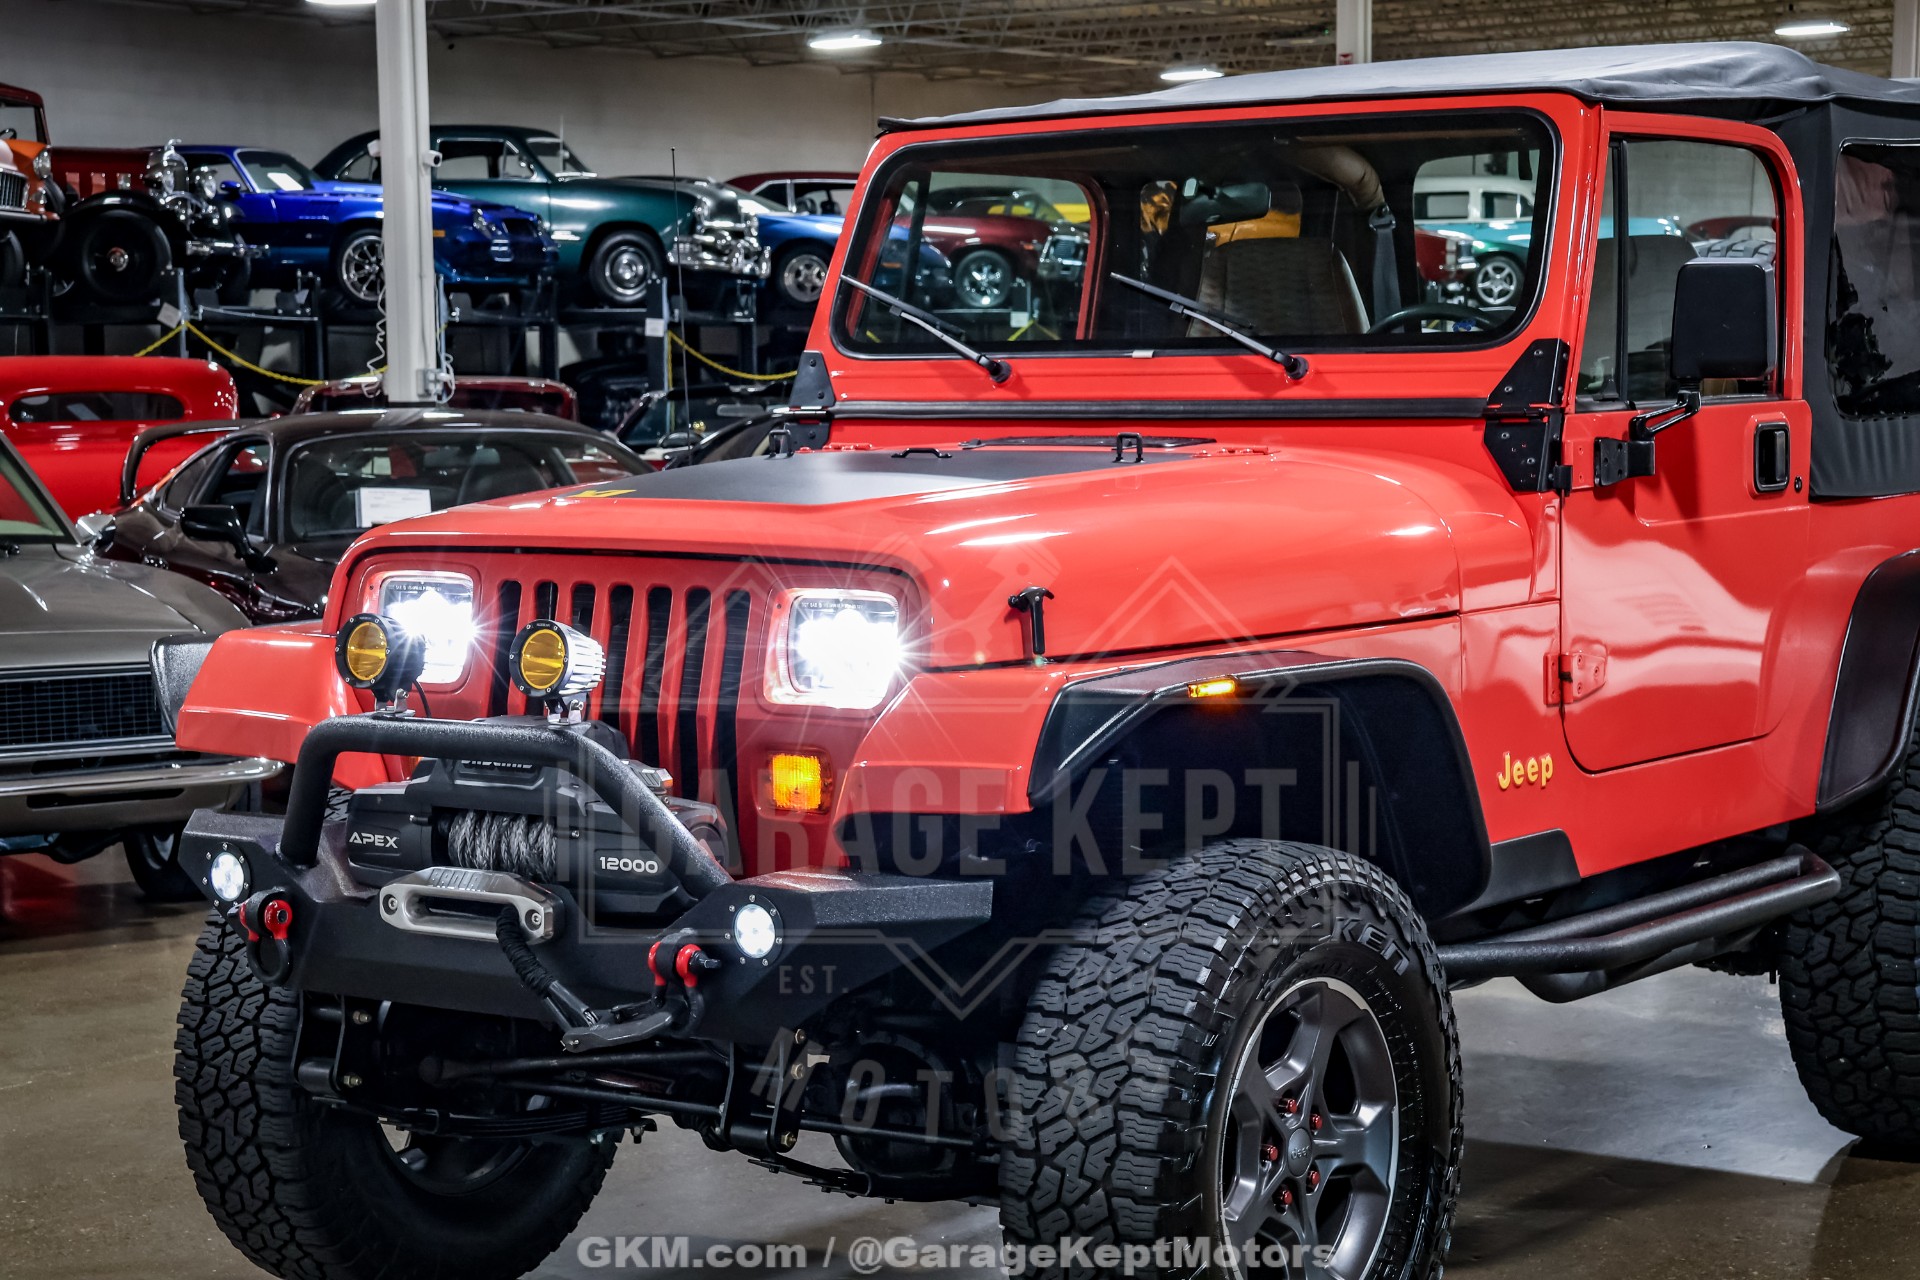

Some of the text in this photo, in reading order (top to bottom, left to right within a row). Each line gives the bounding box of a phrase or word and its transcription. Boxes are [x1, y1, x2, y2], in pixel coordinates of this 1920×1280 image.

[1497, 751, 1553, 789] Jeep
[349, 831, 399, 849] APEX
[599, 856, 659, 874] 12000
